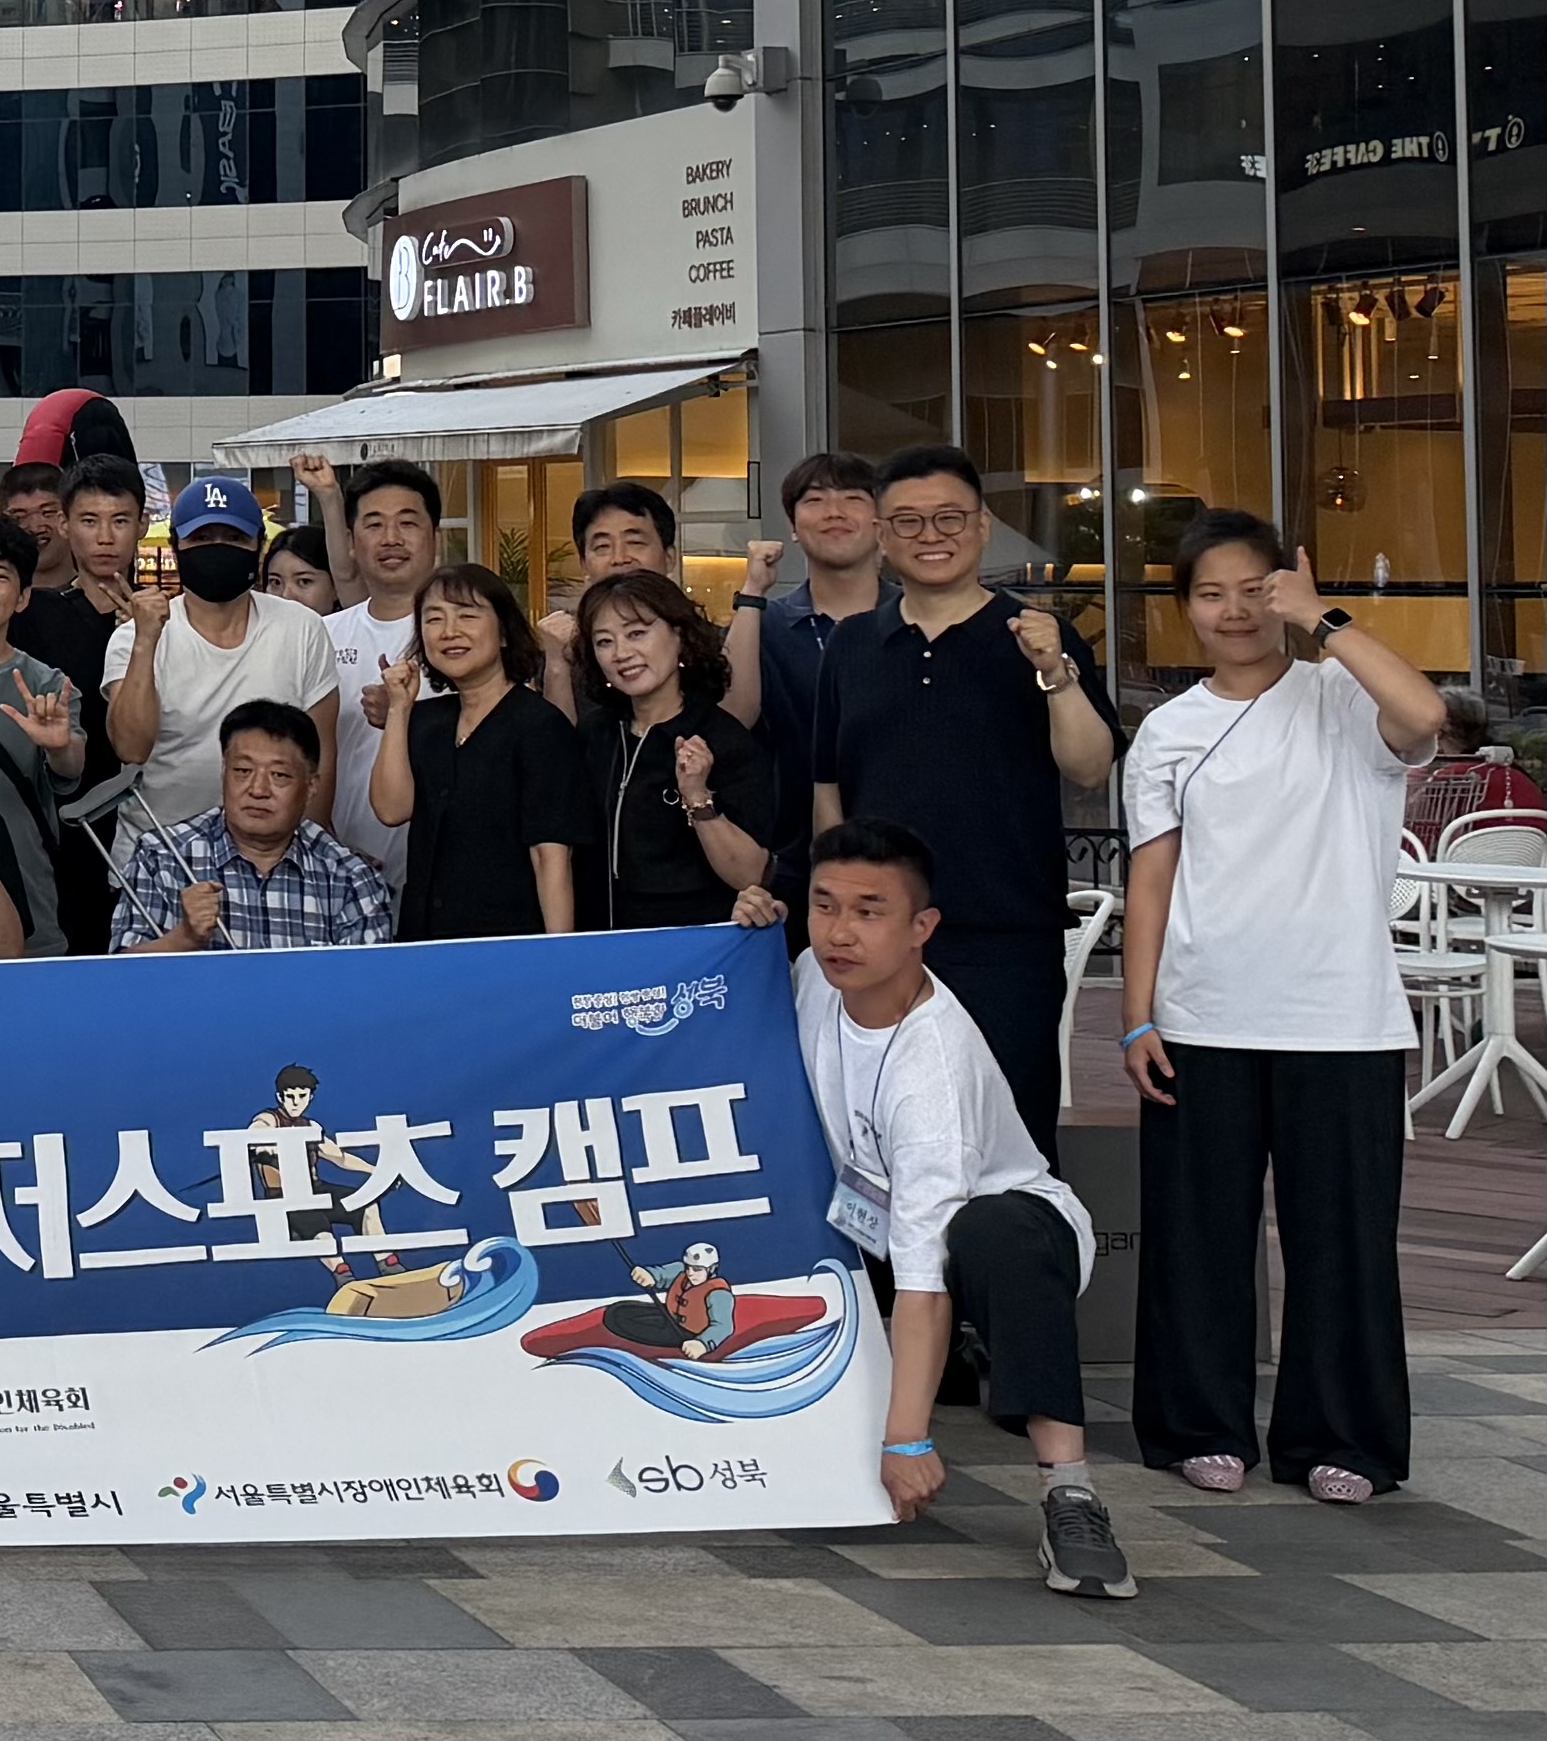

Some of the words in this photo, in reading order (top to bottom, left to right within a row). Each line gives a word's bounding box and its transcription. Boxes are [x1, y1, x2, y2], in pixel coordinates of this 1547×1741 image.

[686, 158, 732, 184] BAKERY
[682, 192, 733, 218] BRUNCH
[696, 226, 733, 249] PASTA
[689, 260, 734, 283] COFFEE
[423, 265, 527, 317] FLAIR.B
[672, 302, 735, 329] 카페플레어비
[205, 484, 228, 508] LA
[491, 1082, 772, 1245] 캠프
[637, 1456, 704, 1494] sb
[710, 1459, 767, 1489] 성북
[215, 1473, 504, 1506] 서울특별시장애인체육회
